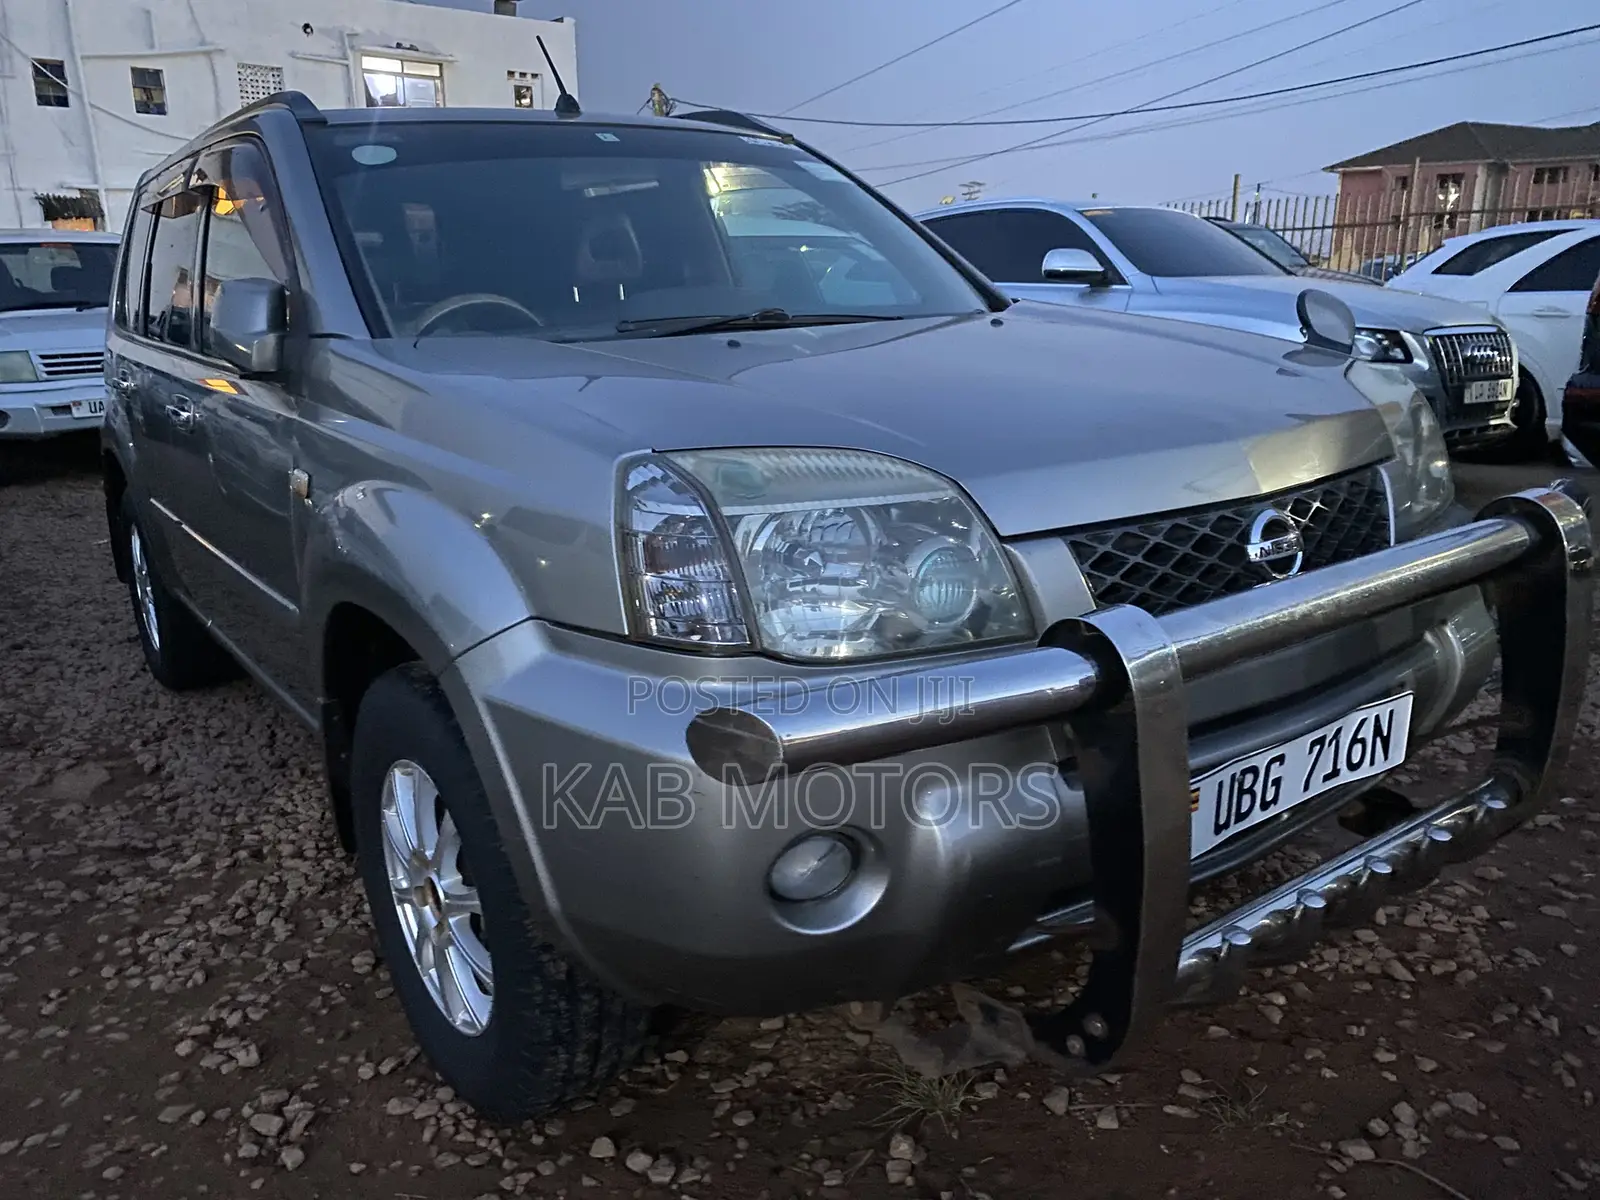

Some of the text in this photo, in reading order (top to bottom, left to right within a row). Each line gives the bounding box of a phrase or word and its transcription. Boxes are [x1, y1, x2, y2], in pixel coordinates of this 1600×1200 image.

[1259, 537, 1298, 558] NISS
[1213, 709, 1395, 836] UBG 716N
